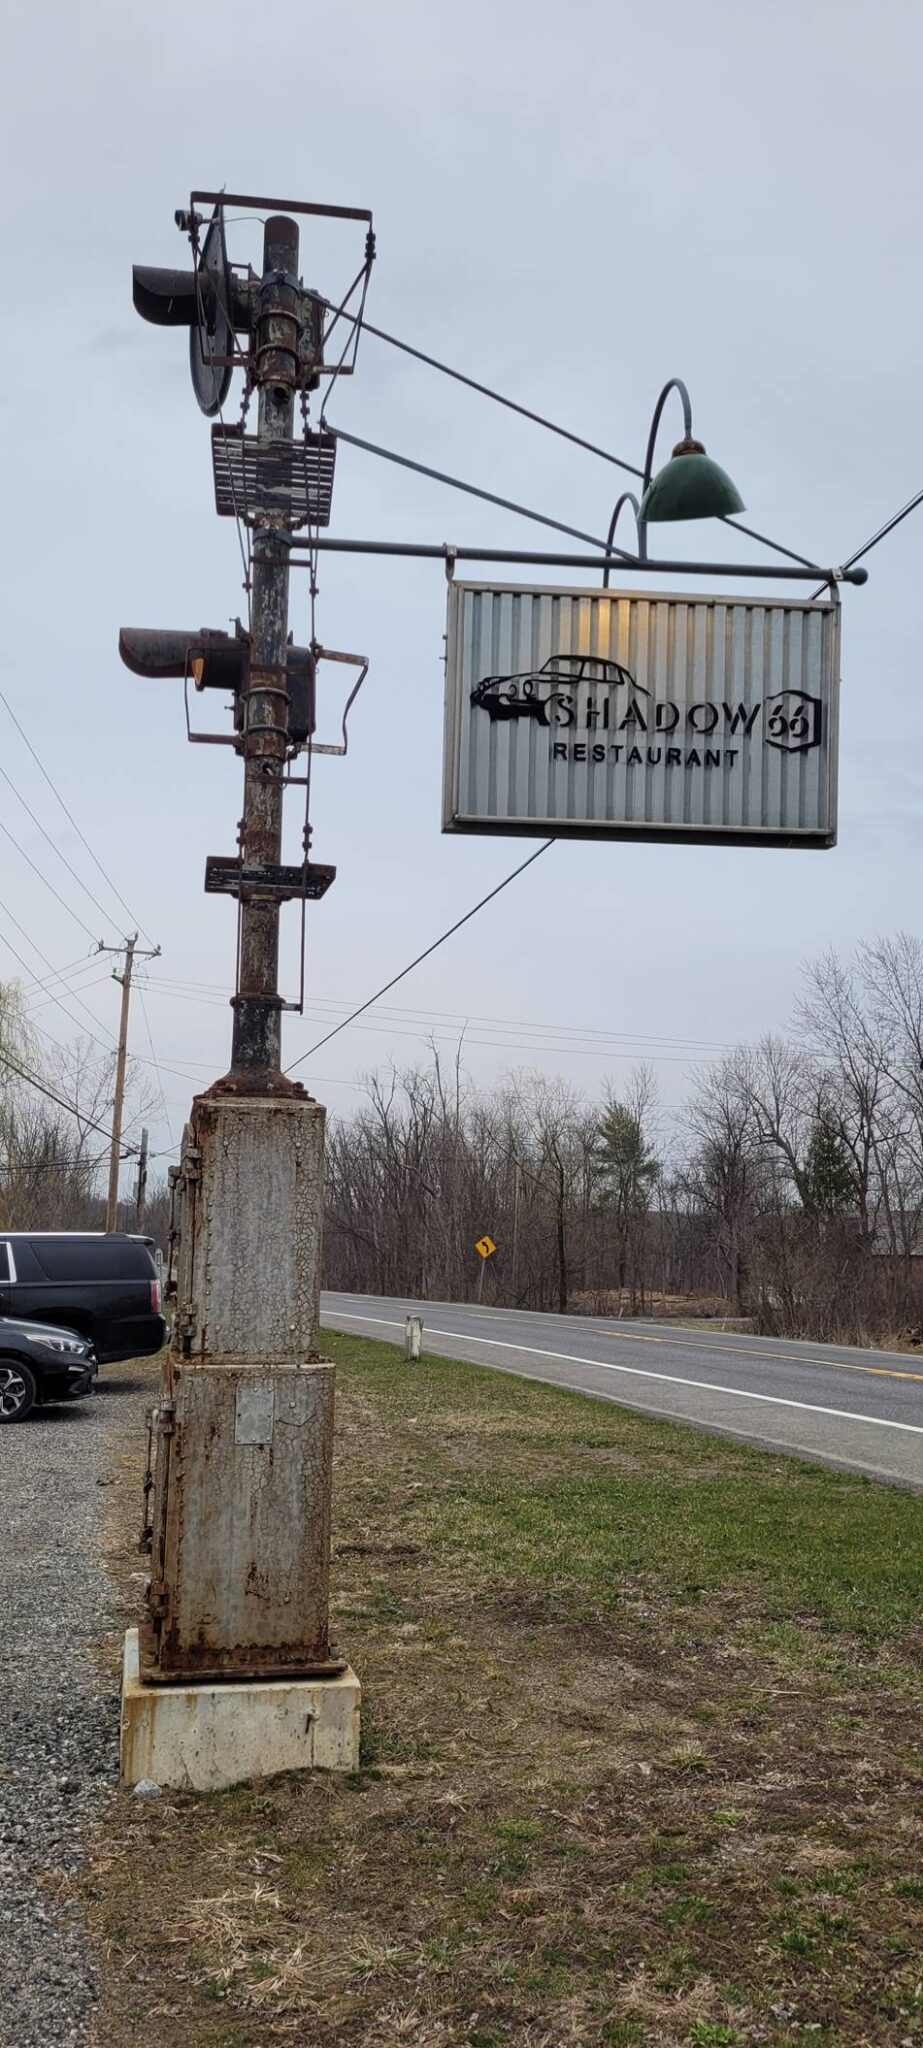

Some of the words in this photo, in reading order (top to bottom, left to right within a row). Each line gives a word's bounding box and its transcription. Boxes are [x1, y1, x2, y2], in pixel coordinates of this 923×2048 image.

[555, 695, 761, 734] SHADOW
[768, 704, 809, 738] 66
[553, 742, 739, 767] RESTAURANT
